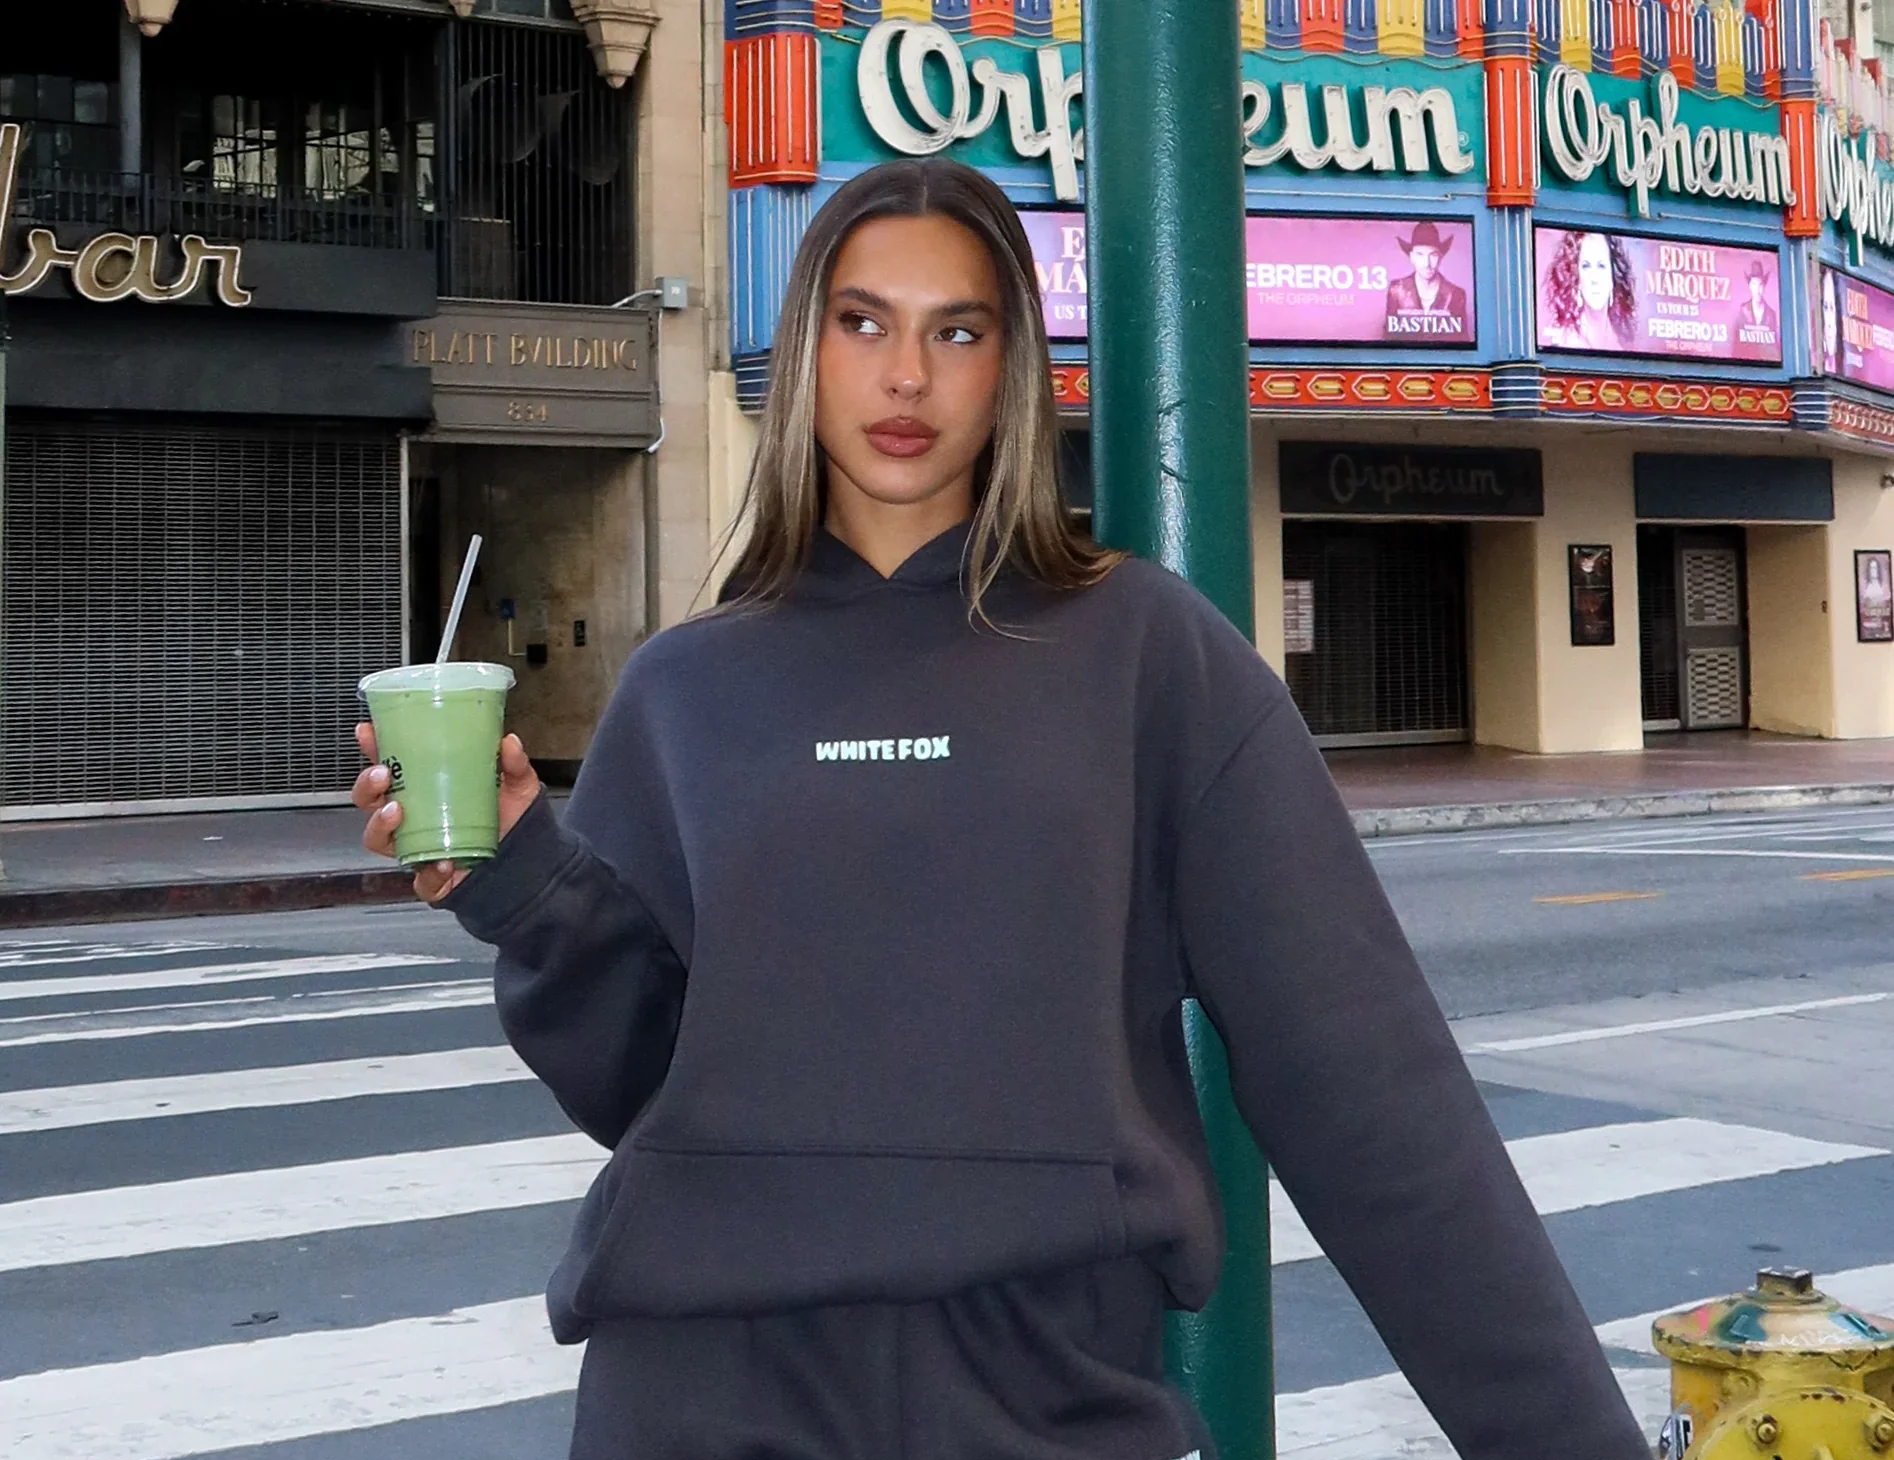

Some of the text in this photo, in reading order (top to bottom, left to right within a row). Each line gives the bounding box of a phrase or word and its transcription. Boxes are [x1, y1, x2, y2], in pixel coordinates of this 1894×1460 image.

[857, 18, 1474, 201] Orpeum
[1545, 63, 1797, 219] Orpheum
[1660, 246, 1716, 274] EDITH
[1246, 263, 1387, 290] EBRERO 13
[1256, 292, 1284, 305] THE
[1054, 305, 1075, 320] US
[1387, 315, 1462, 333] BASTIAN
[1648, 318, 1728, 342] FEBRERO 13
[1739, 329, 1776, 344] BASTIAN
[412, 329, 498, 365] PLATT
[1329, 453, 1504, 504] Orpheum
